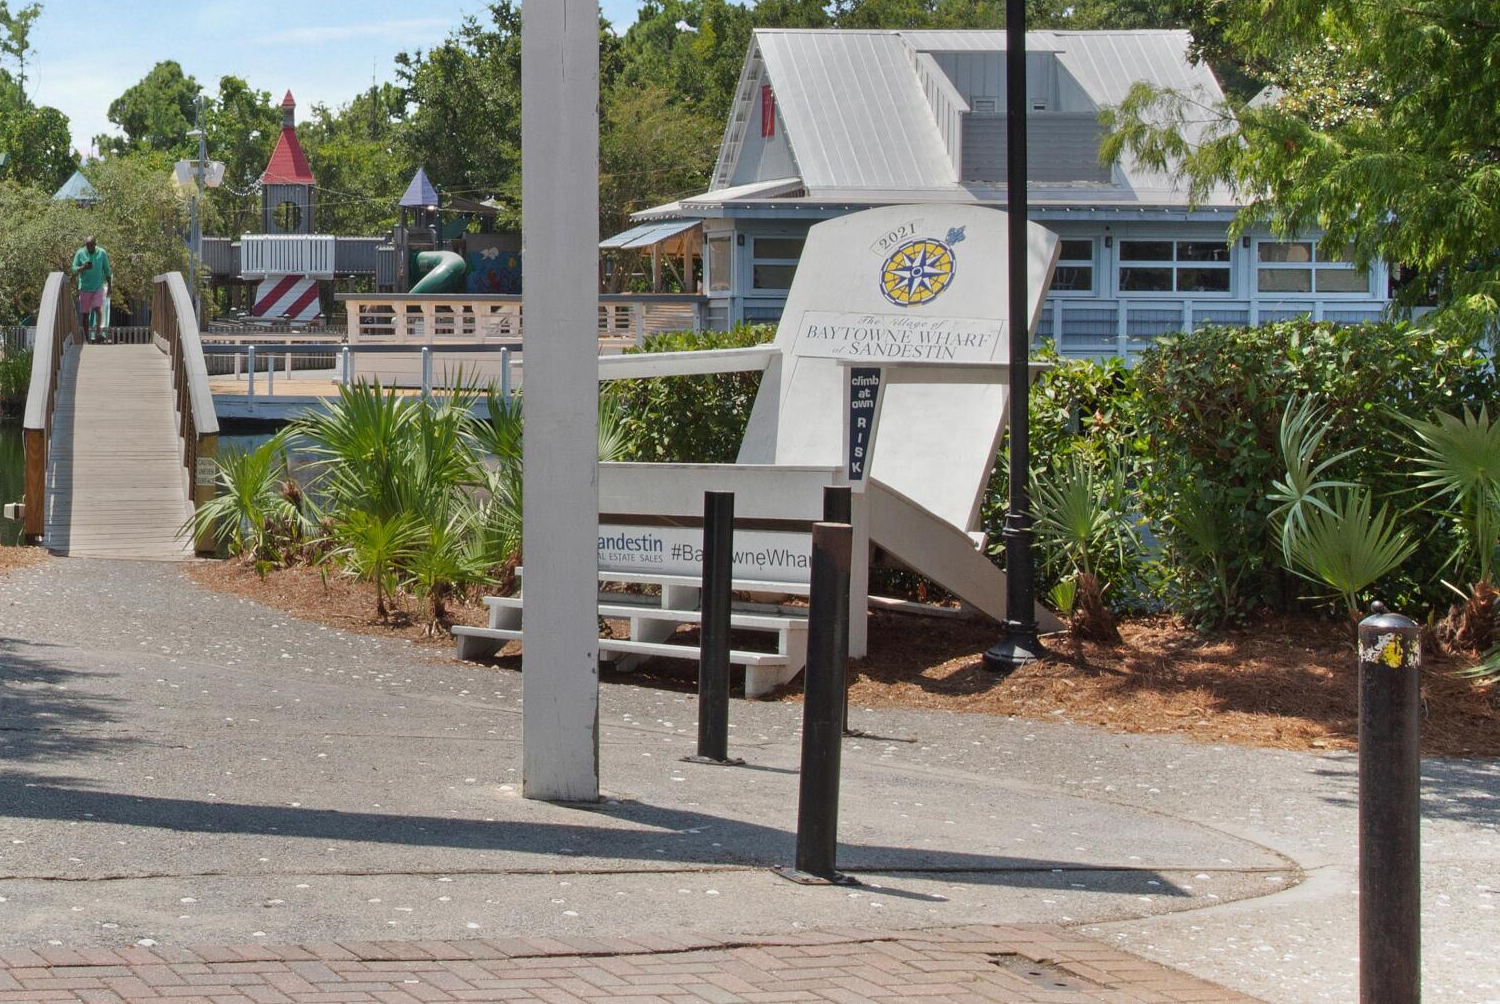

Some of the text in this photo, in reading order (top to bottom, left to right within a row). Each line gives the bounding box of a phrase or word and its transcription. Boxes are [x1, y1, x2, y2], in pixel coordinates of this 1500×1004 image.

[879, 223, 917, 250] 2021
[858, 315, 881, 326] The
[806, 324, 991, 348] BAYTOWNE WHARF
[848, 341, 958, 359] SANDESTIN
[851, 375, 879, 386] climb
[858, 388, 871, 398] at
[851, 400, 874, 409] own
[851, 417, 867, 473] RISK
[598, 533, 663, 552] andestin
[609, 553, 636, 562] ESTATE
[640, 554, 664, 564] SALES
